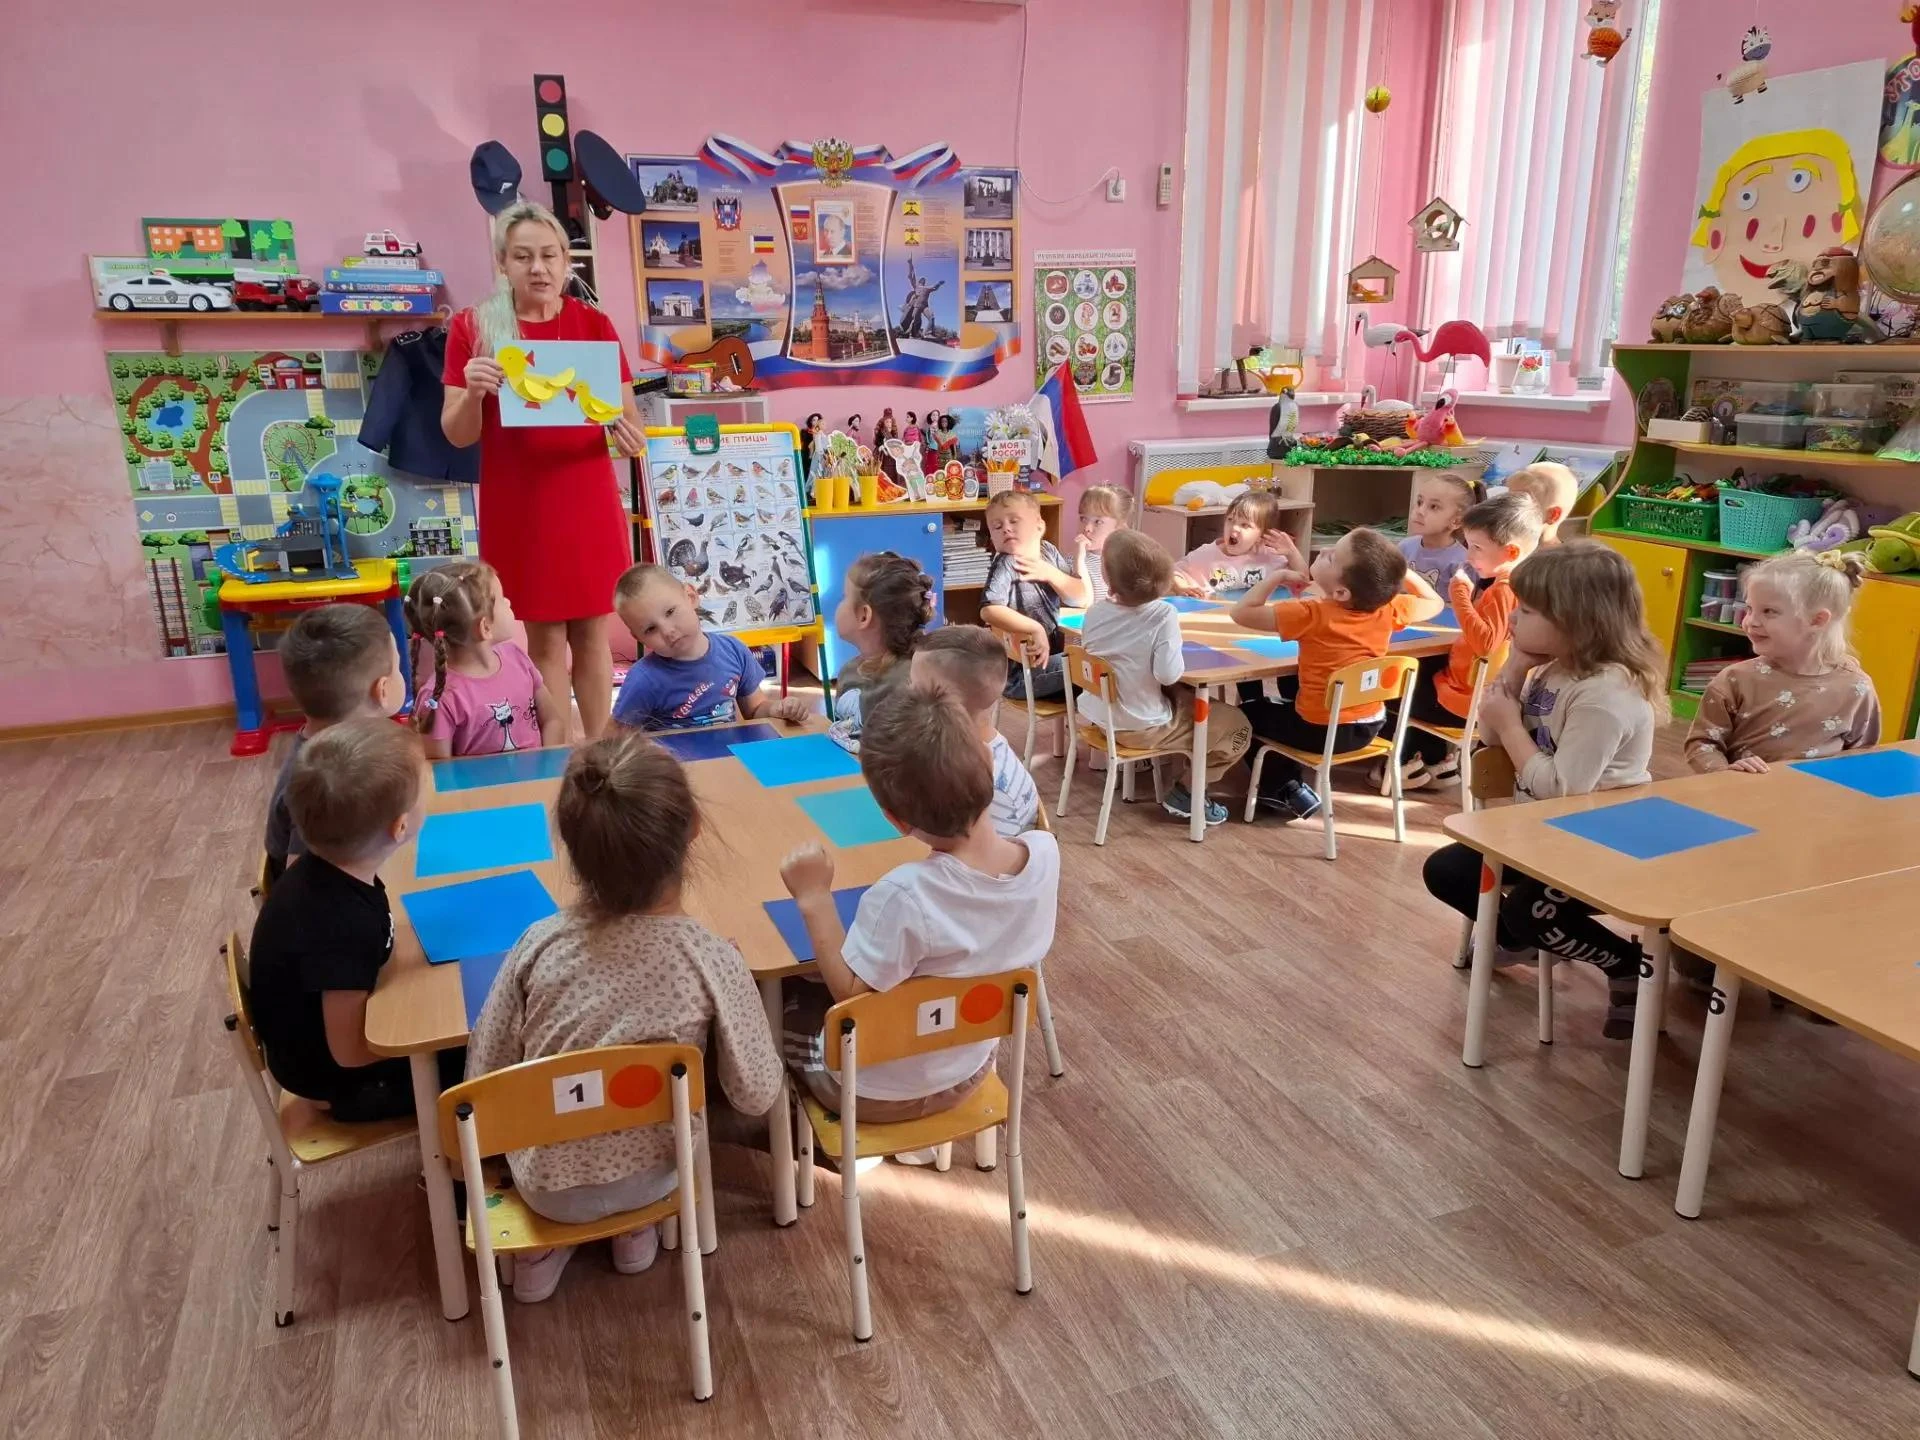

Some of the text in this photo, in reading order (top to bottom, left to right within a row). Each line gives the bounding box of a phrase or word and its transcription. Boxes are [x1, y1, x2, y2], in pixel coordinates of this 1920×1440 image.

[733, 434, 768, 444] ПТИЦЫ
[1000, 441, 1019, 449] МОЯ
[992, 449, 1026, 457] РОССИЯ
[1538, 926, 1621, 968] ACTIVE
[929, 1007, 942, 1026] 1
[569, 1082, 585, 1103] 1
